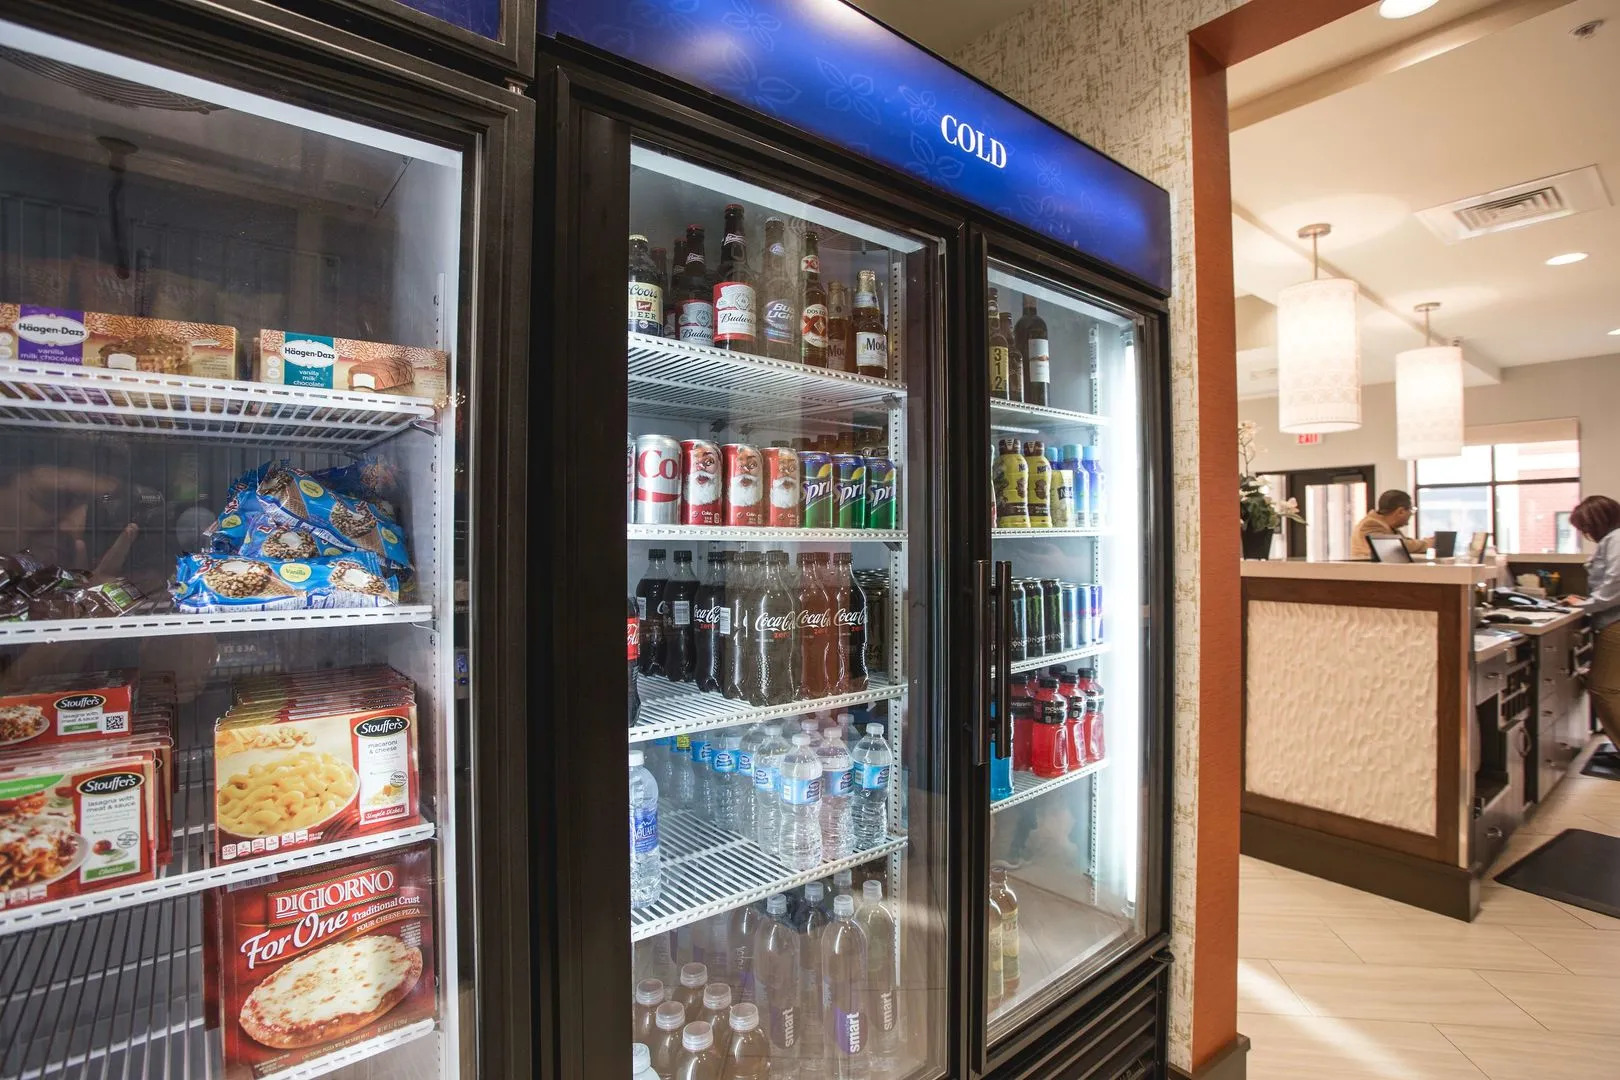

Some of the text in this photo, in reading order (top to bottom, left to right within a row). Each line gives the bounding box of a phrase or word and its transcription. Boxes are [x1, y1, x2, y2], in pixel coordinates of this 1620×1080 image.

[941, 115, 1007, 169] COLD
[18, 322, 84, 337] Häagen-Dazs
[40, 354, 80, 363] chocolate
[284, 347, 335, 359] Häagen-Dazs
[299, 369, 319, 377] vanilla
[60, 695, 100, 709] Stouffer's
[360, 717, 403, 735] Stouffer's
[368, 740, 398, 748] macaroni
[375, 746, 397, 754] cheese
[85, 774, 137, 793] Stouffer's
[86, 805, 106, 813] meat
[114, 801, 136, 809] sauce
[88, 798, 117, 808] lasagna
[223, 845, 235, 853] 320
[276, 870, 395, 915] DIGIORNO
[351, 895, 421, 922] Traditional Crust
[356, 907, 420, 932] FOUR CHEESE PIZZA
[240, 910, 350, 970] For One
[881, 991, 893, 1031] smart
[782, 1007, 794, 1048] smart
[846, 1011, 860, 1053] smart
